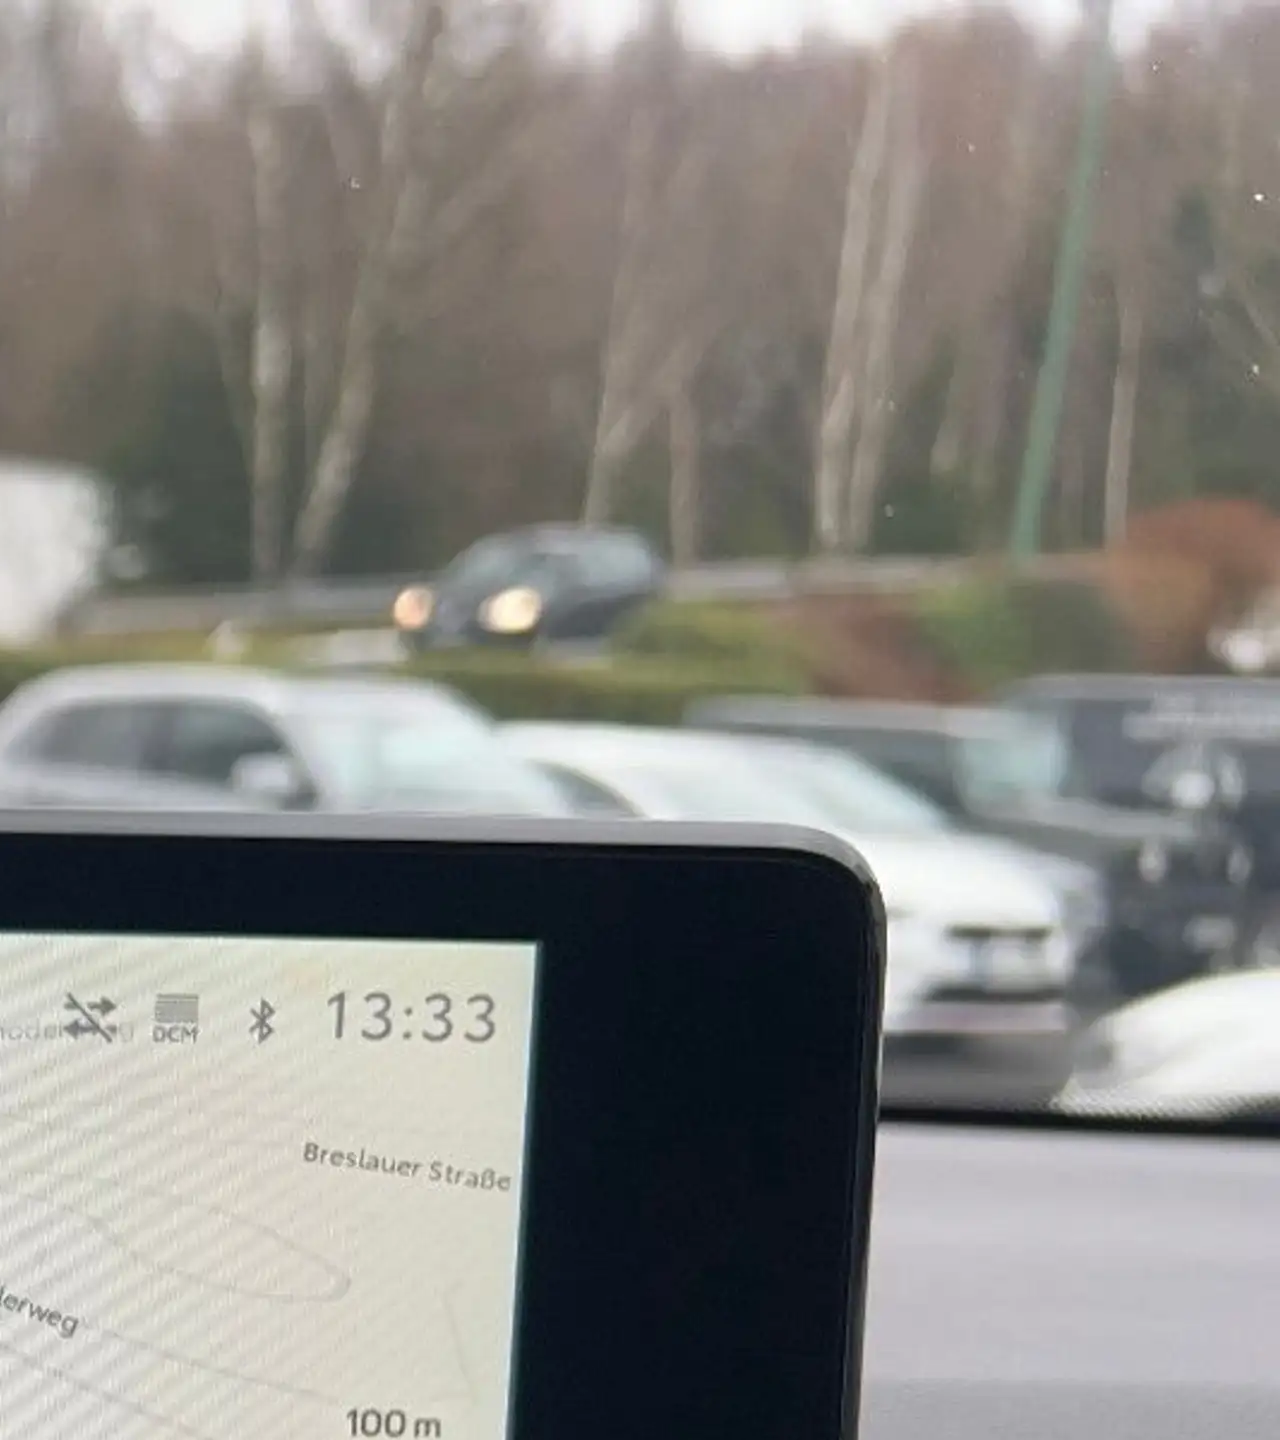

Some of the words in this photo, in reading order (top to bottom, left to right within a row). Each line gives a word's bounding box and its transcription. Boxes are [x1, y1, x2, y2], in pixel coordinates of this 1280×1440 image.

[151, 1025, 200, 1044] DCM
[327, 990, 496, 1043] 13:33
[302, 1141, 422, 1178] Breslauer
[427, 1160, 513, 1192] Straße
[346, 1408, 407, 1438] 100
[413, 1417, 442, 1439] m
